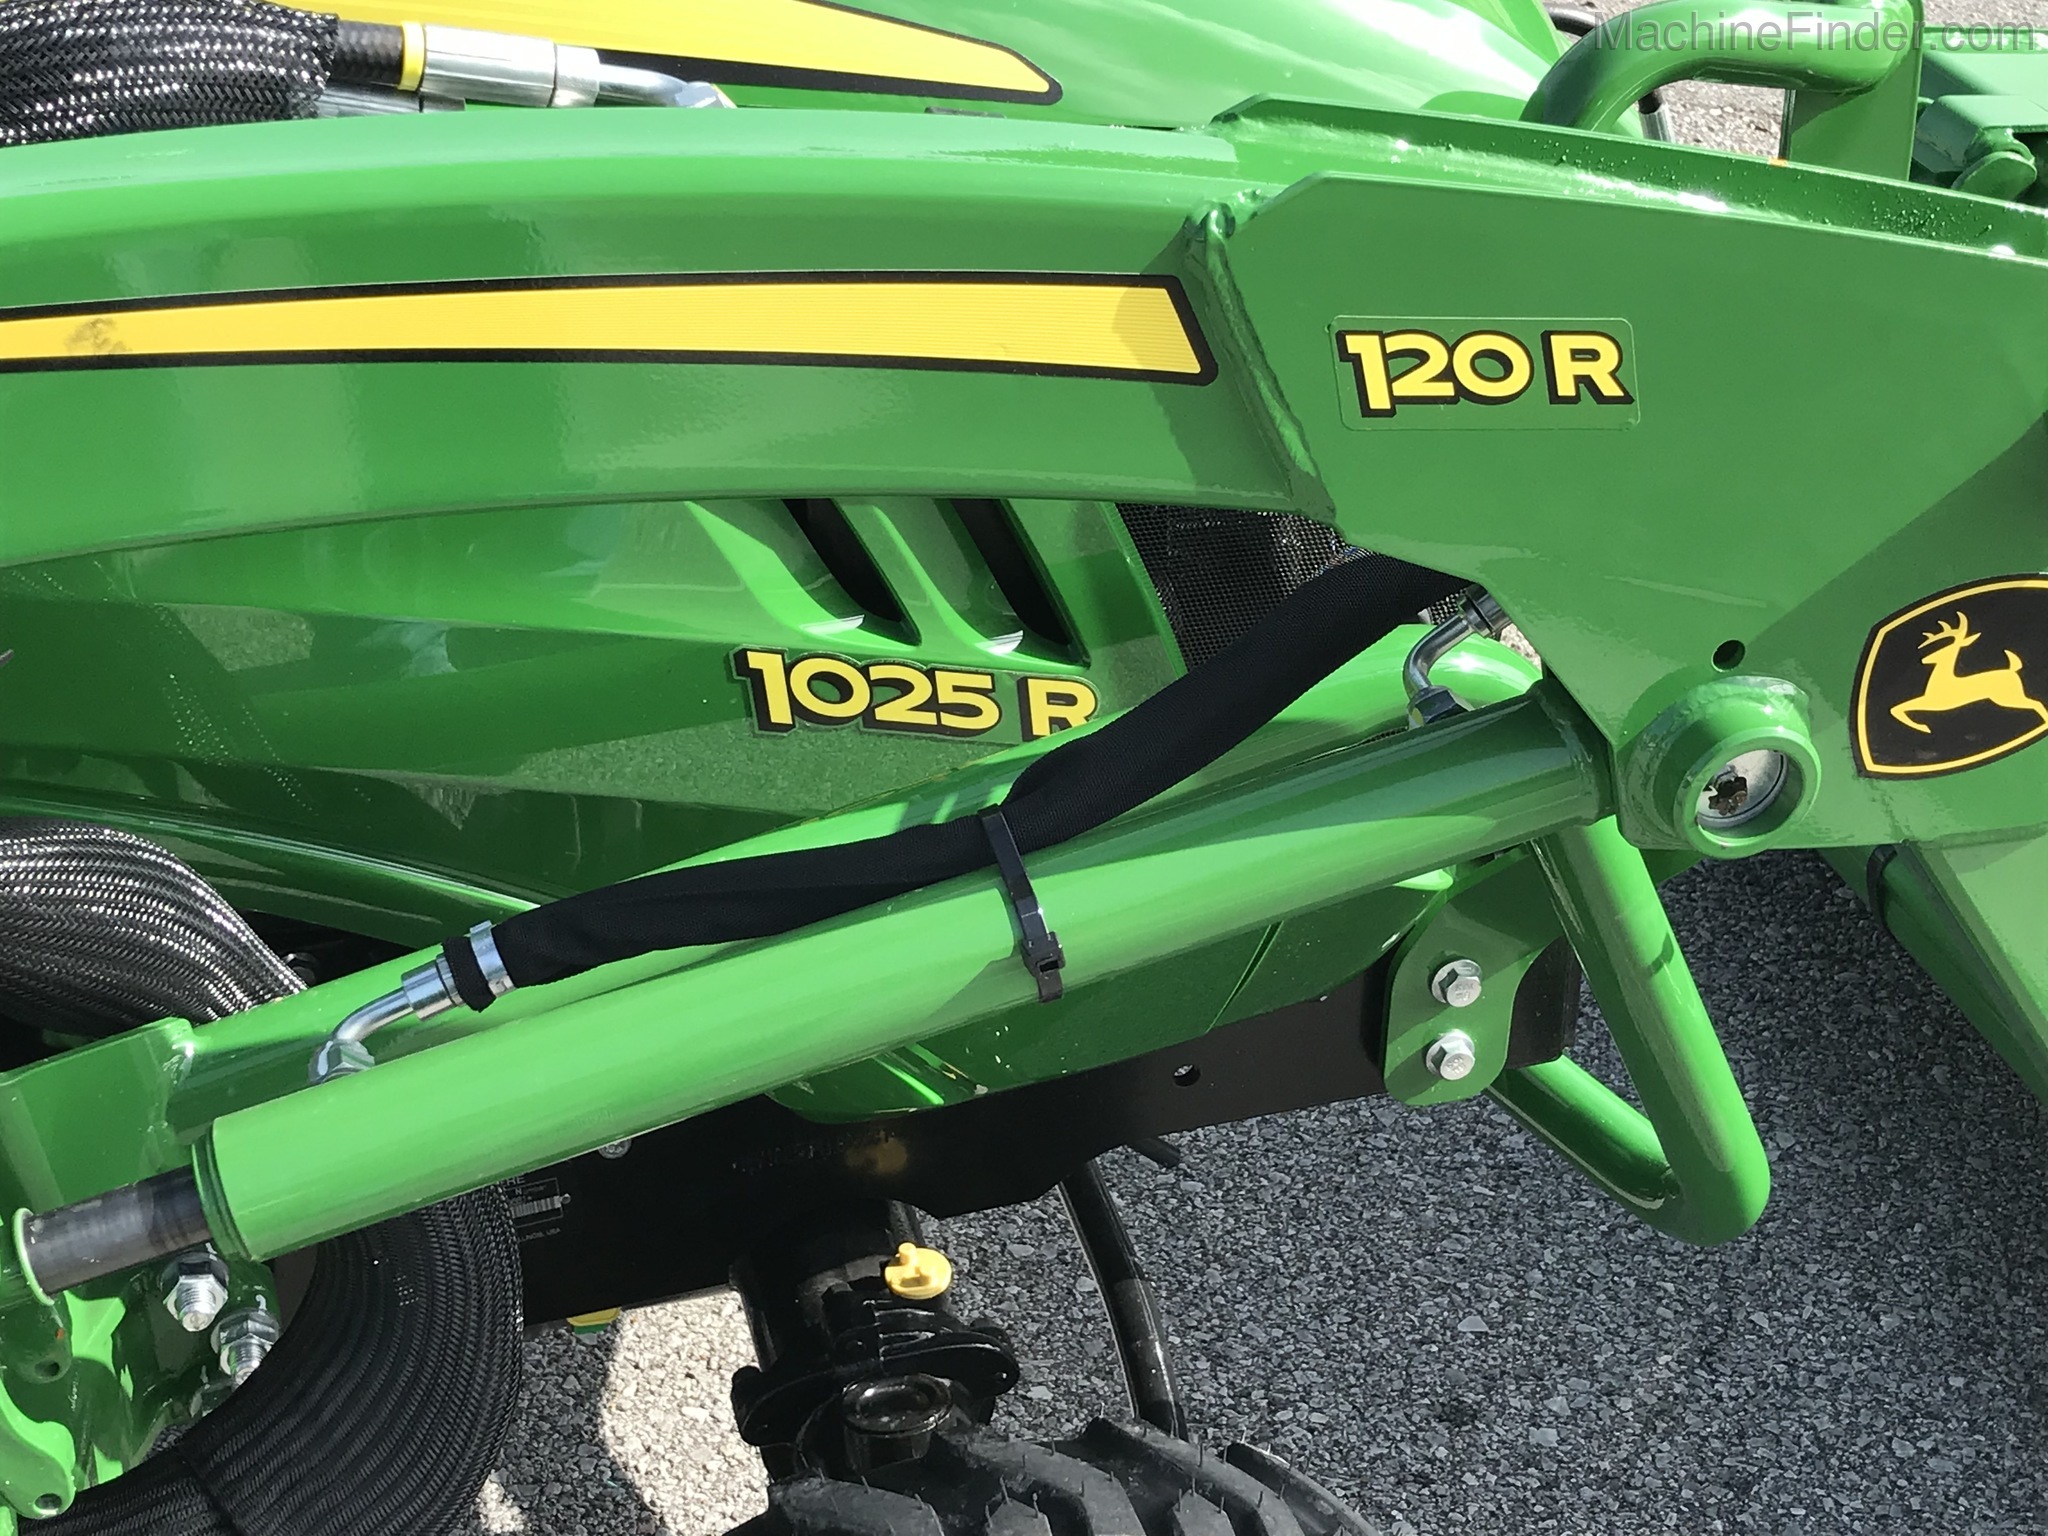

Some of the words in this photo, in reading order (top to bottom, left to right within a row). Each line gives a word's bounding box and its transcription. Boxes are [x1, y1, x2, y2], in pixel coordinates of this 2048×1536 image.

[1336, 329, 1535, 418] 120
[1540, 329, 1636, 405] R
[734, 648, 1002, 737] 1025
[1016, 676, 1099, 742] R
